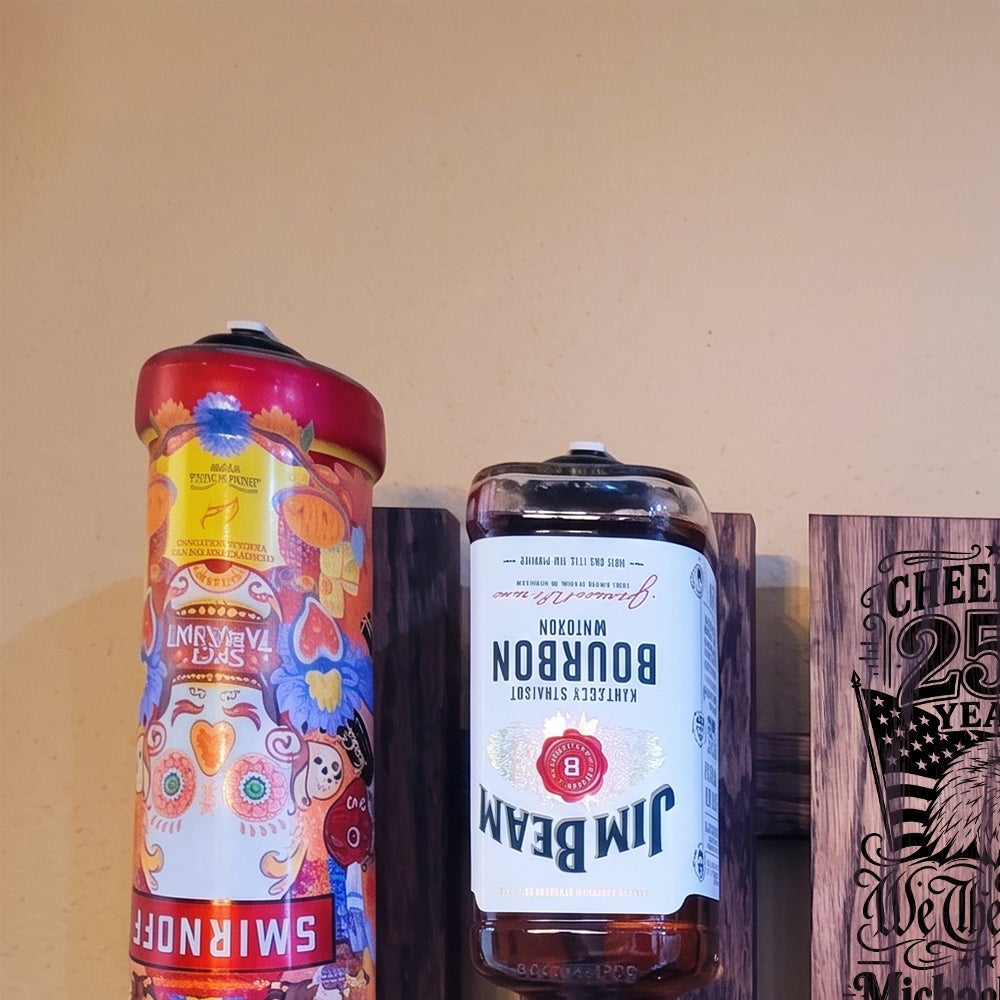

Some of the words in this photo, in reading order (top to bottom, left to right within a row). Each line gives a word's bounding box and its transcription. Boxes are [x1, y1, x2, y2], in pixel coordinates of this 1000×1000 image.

[492, 640, 657, 685] BOURBON
[562, 755, 579, 776] B
[477, 782, 587, 873] BEAM
[594, 783, 675, 859] JIM
[131, 908, 316, 958] SMIRNOFF
[855, 866, 937, 940] We
